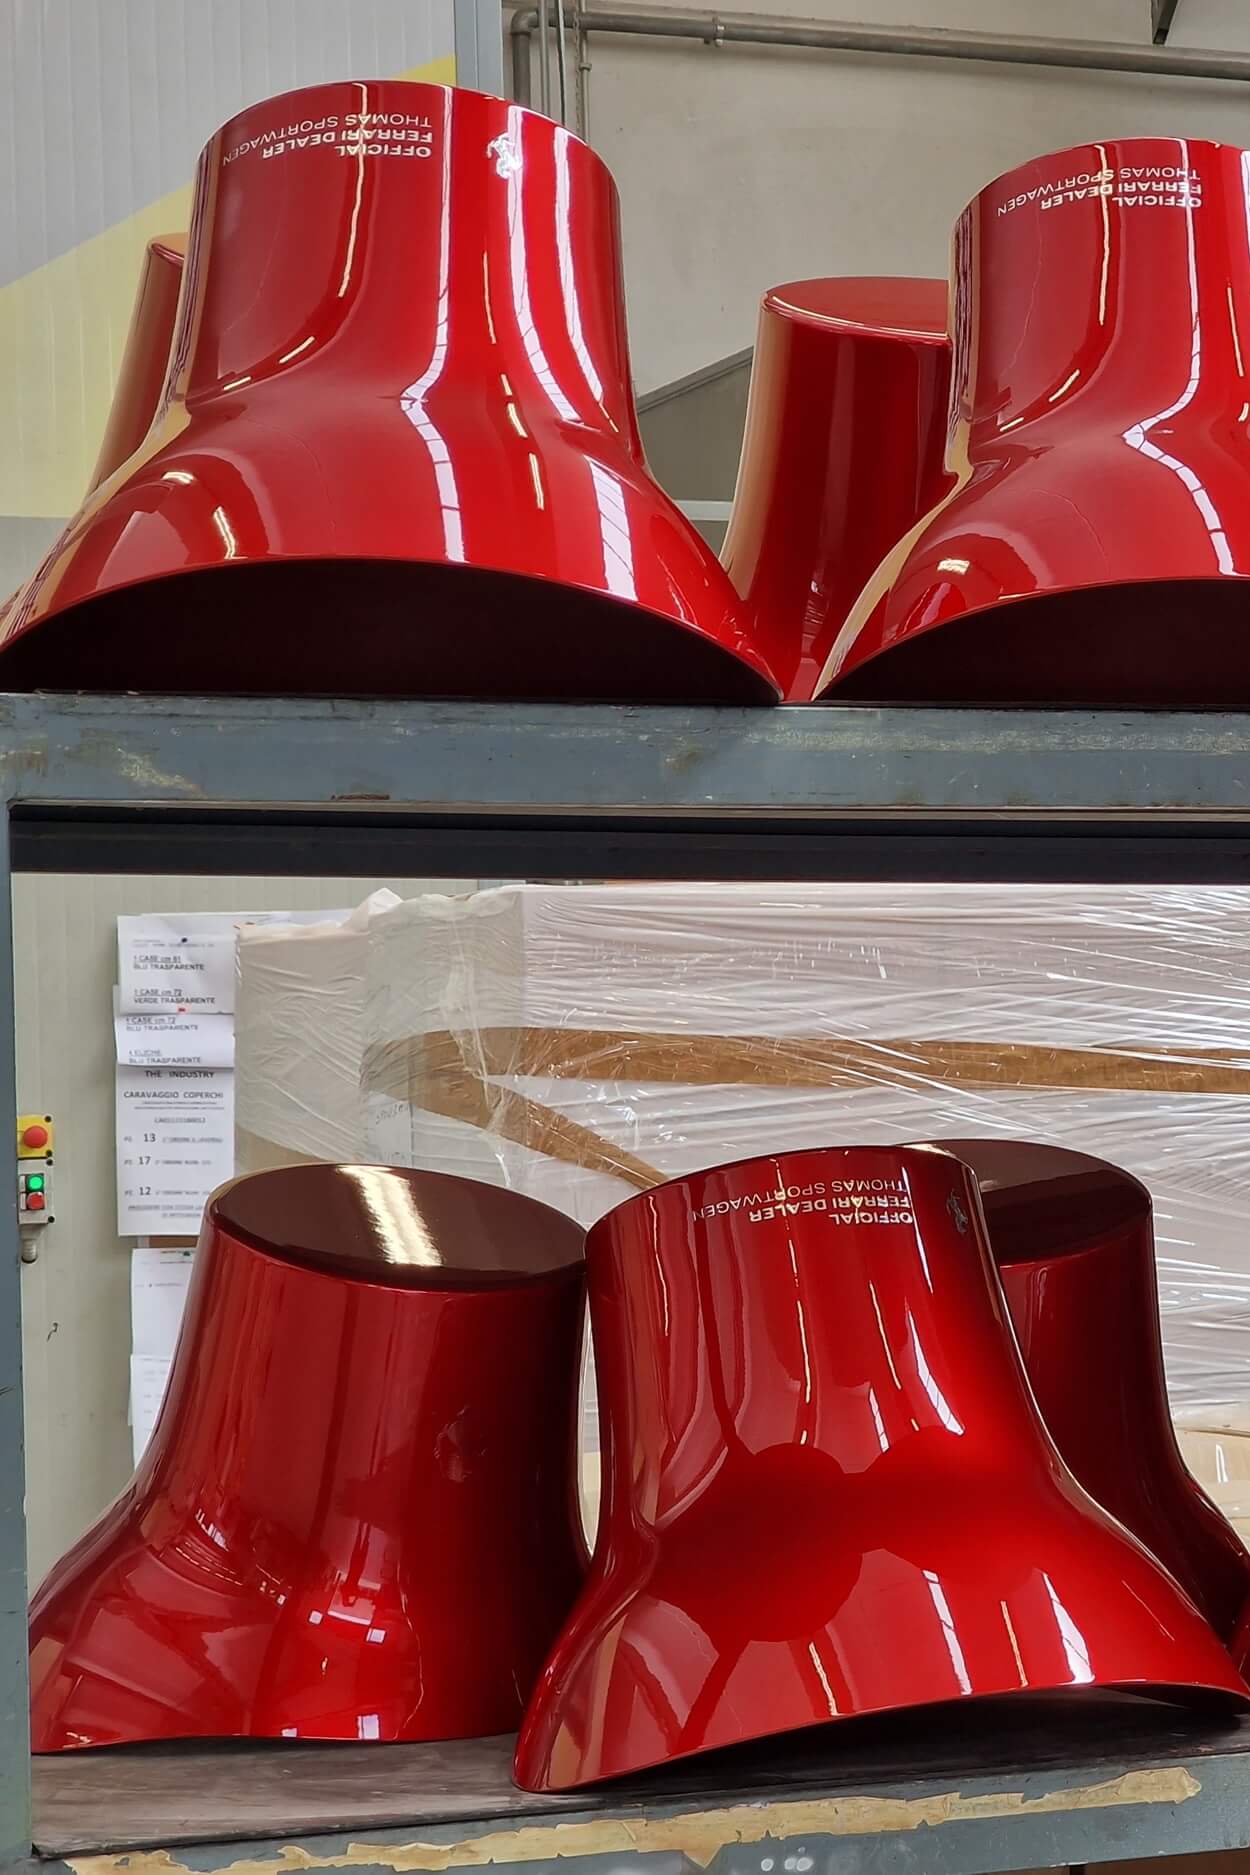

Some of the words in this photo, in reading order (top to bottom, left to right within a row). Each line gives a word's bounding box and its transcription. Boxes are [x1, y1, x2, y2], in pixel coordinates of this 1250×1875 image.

[346, 114, 432, 127] THOMAS
[223, 115, 338, 167] SPORTWAGEN
[342, 129, 432, 143] FERRARI
[262, 131, 336, 159] DEALER
[335, 144, 431, 157] OFFICIAL
[1121, 167, 1201, 180] THOMAS
[997, 169, 1114, 216] SPORTWAGEN
[1119, 181, 1202, 195] FERRARI
[1041, 184, 1114, 211] DEALER
[1112, 196, 1202, 208] OFFICIAL
[150, 963, 205, 971] TRASPARENTE
[145, 1070, 162, 1078] THE
[143, 1133, 156, 1142] 13
[138, 1156, 151, 1165] 17
[139, 1187, 151, 1196] 12
[832, 1179, 906, 1192] THOMAS
[693, 1179, 826, 1222] SPORTWAGEN
[832, 1194, 911, 1208] FERRARI
[749, 1197, 828, 1223] DEALER
[829, 1211, 914, 1225] OFFICIAL
